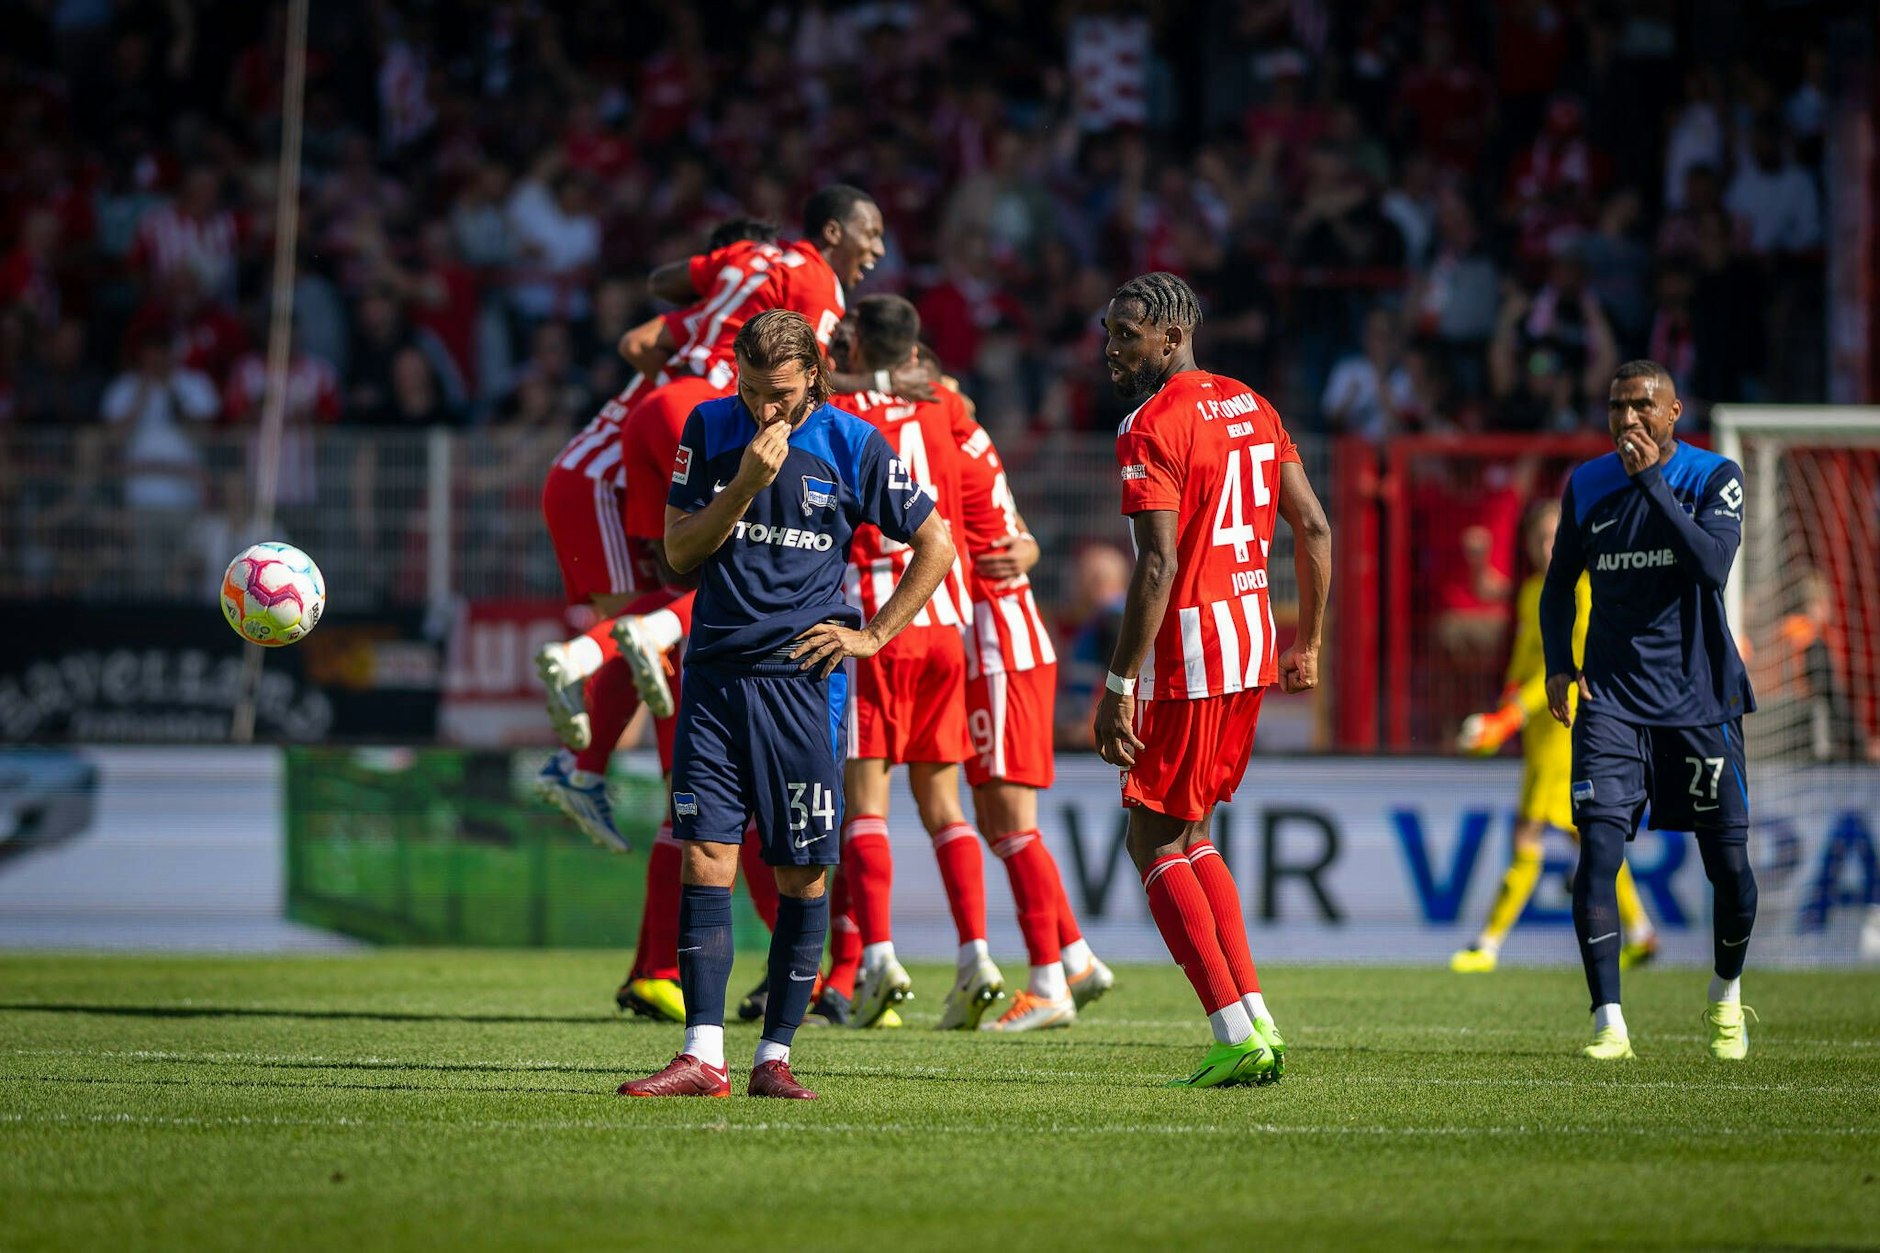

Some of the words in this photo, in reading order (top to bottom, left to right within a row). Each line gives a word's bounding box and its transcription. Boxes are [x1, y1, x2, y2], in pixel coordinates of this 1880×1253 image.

[1122, 464, 1146, 473] OMEDY
[1212, 443, 1275, 563] 45
[1596, 549, 1677, 571] AUTOHE
[1685, 757, 1724, 800] 27
[787, 783, 835, 831] 34
